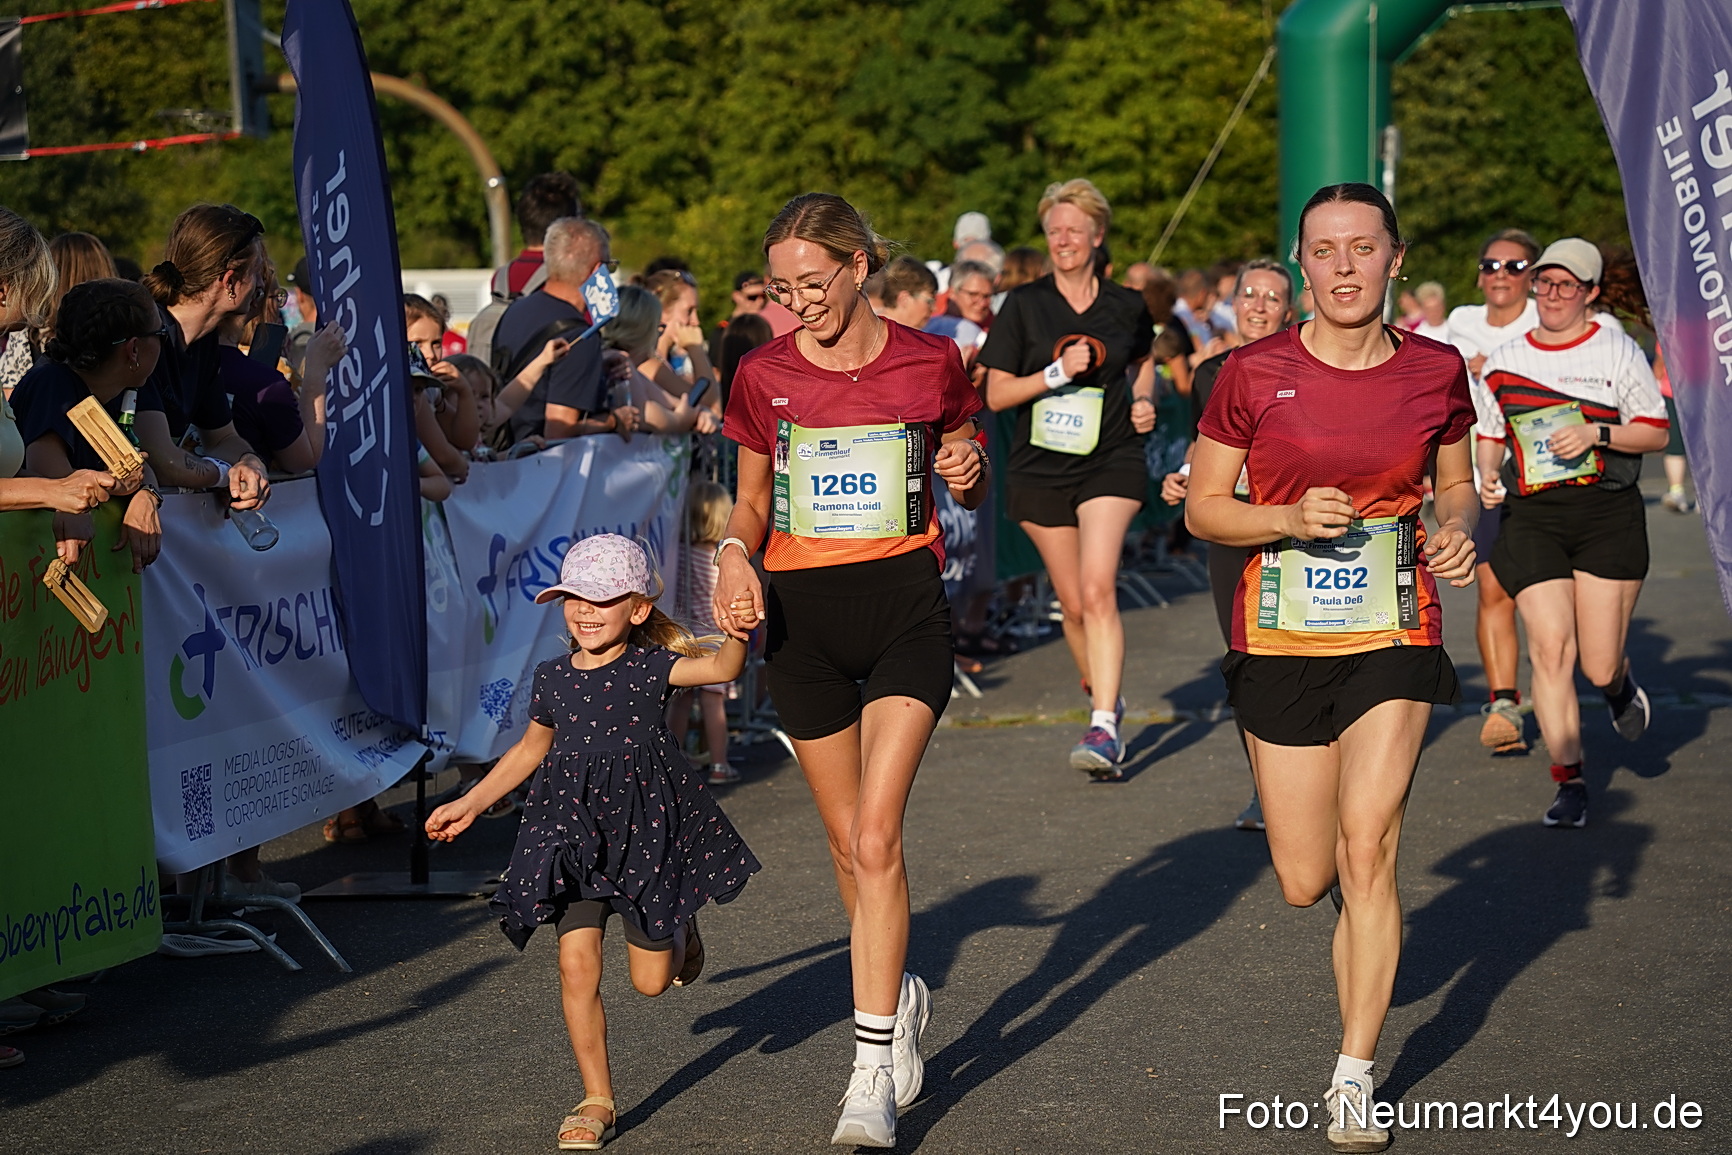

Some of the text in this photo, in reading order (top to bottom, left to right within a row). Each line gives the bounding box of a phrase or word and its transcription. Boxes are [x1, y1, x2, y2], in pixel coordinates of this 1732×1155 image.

[1044, 411, 1084, 427] 2776
[814, 448, 851, 458] Firmenlauf
[810, 472, 877, 496] 1266
[812, 501, 882, 511] Ramona Loidl
[1304, 567, 1368, 589] 1262
[1312, 595, 1364, 605] Paula Deß
[1402, 588, 1410, 622] HILTL
[36, 586, 141, 693] länger!
[216, 586, 344, 671] FRISCH
[224, 735, 315, 778] MEDIA LOGISTICS
[223, 755, 323, 802] CORPORATE PRINT
[224, 774, 336, 828] CORPORATE SIGNAGE
